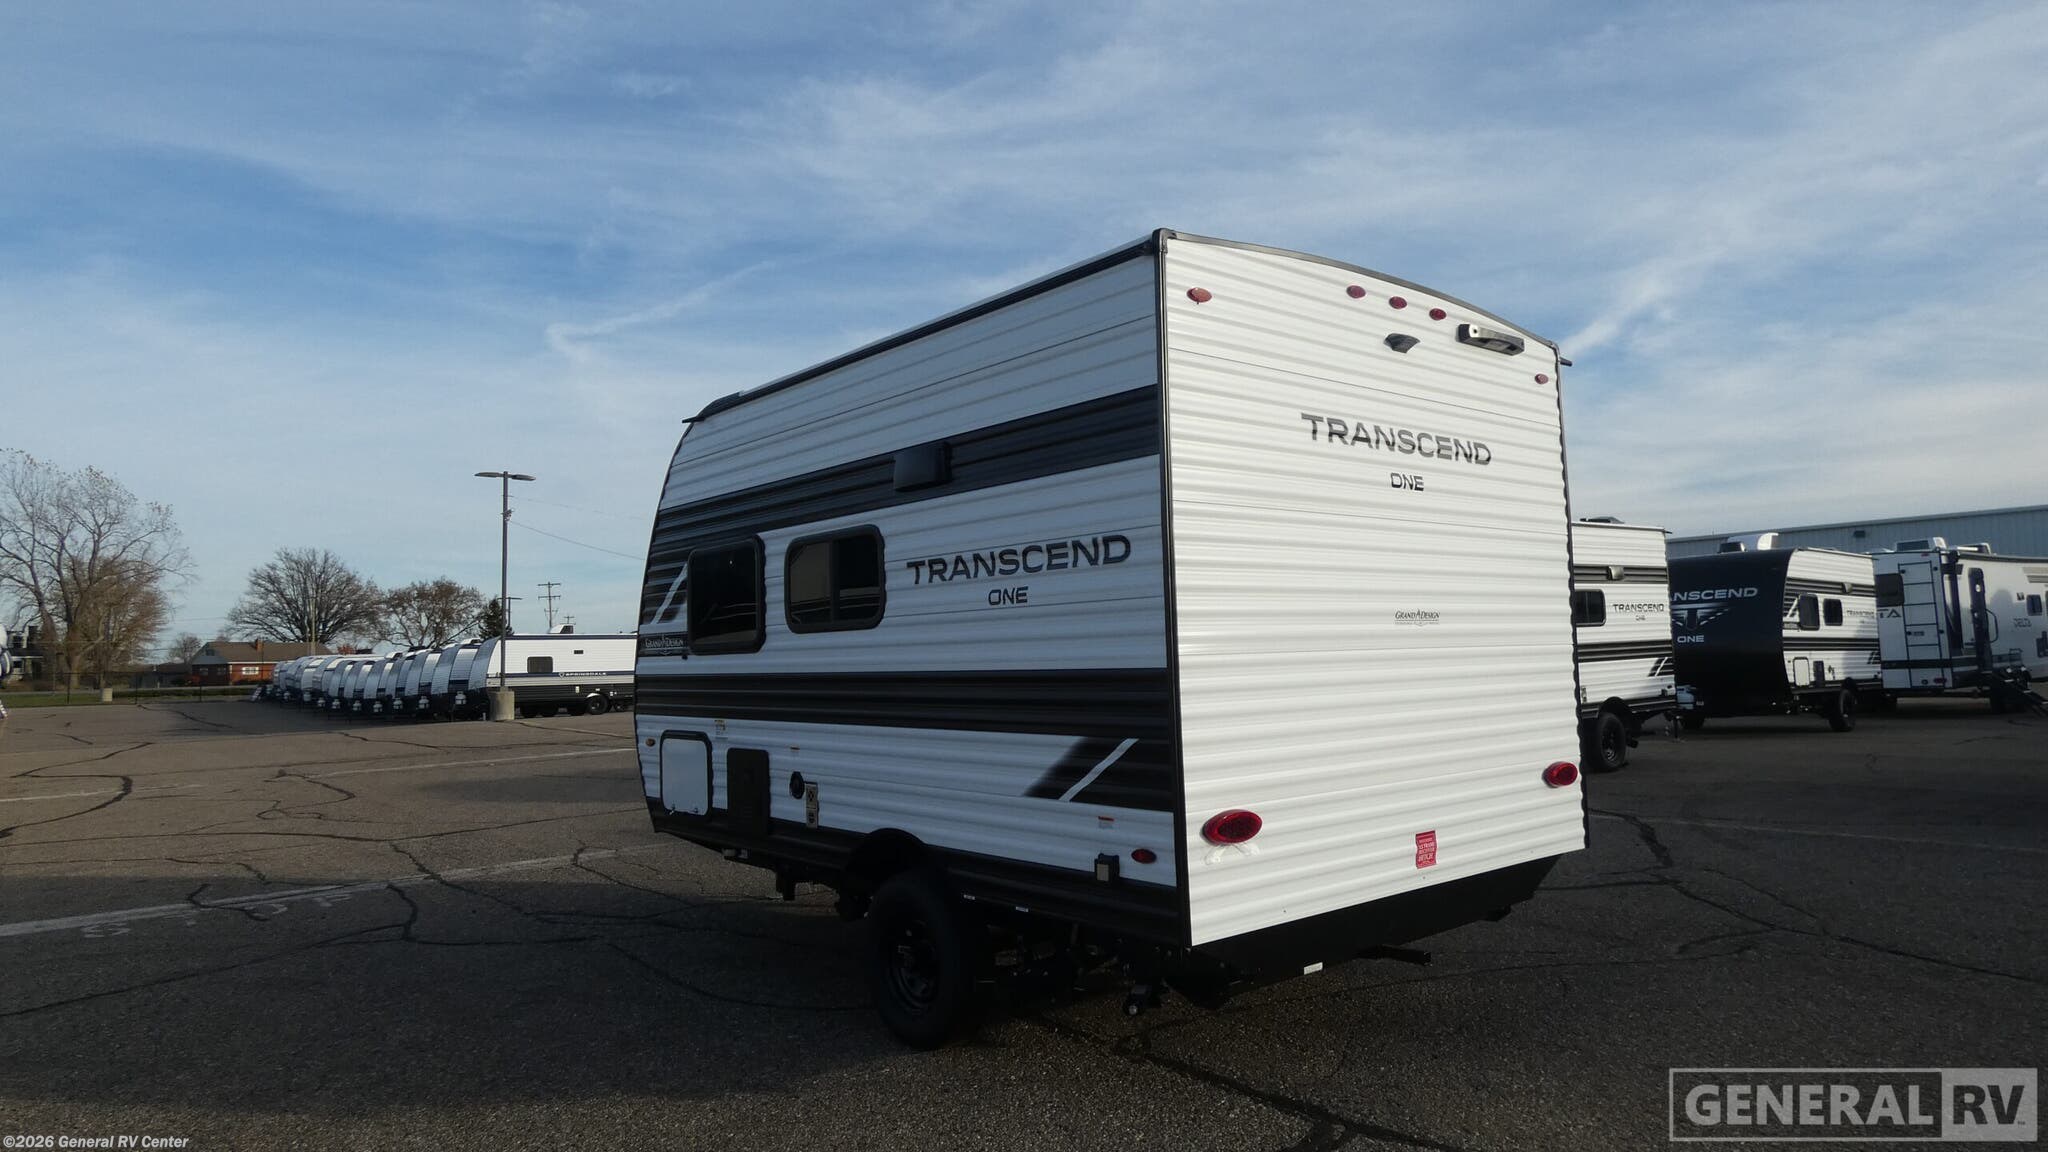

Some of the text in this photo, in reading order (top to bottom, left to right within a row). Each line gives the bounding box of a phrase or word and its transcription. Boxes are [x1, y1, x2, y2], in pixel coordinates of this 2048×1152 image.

[1300, 412, 1492, 466] TRANSCEND
[1390, 472, 1425, 491] ONE
[906, 534, 1132, 585] TRANSCEND
[988, 586, 1029, 606] ONE
[1672, 587, 1758, 601] NSCEND
[1613, 603, 1664, 613] TRANSCEND
[1677, 635, 1705, 643] ONE
